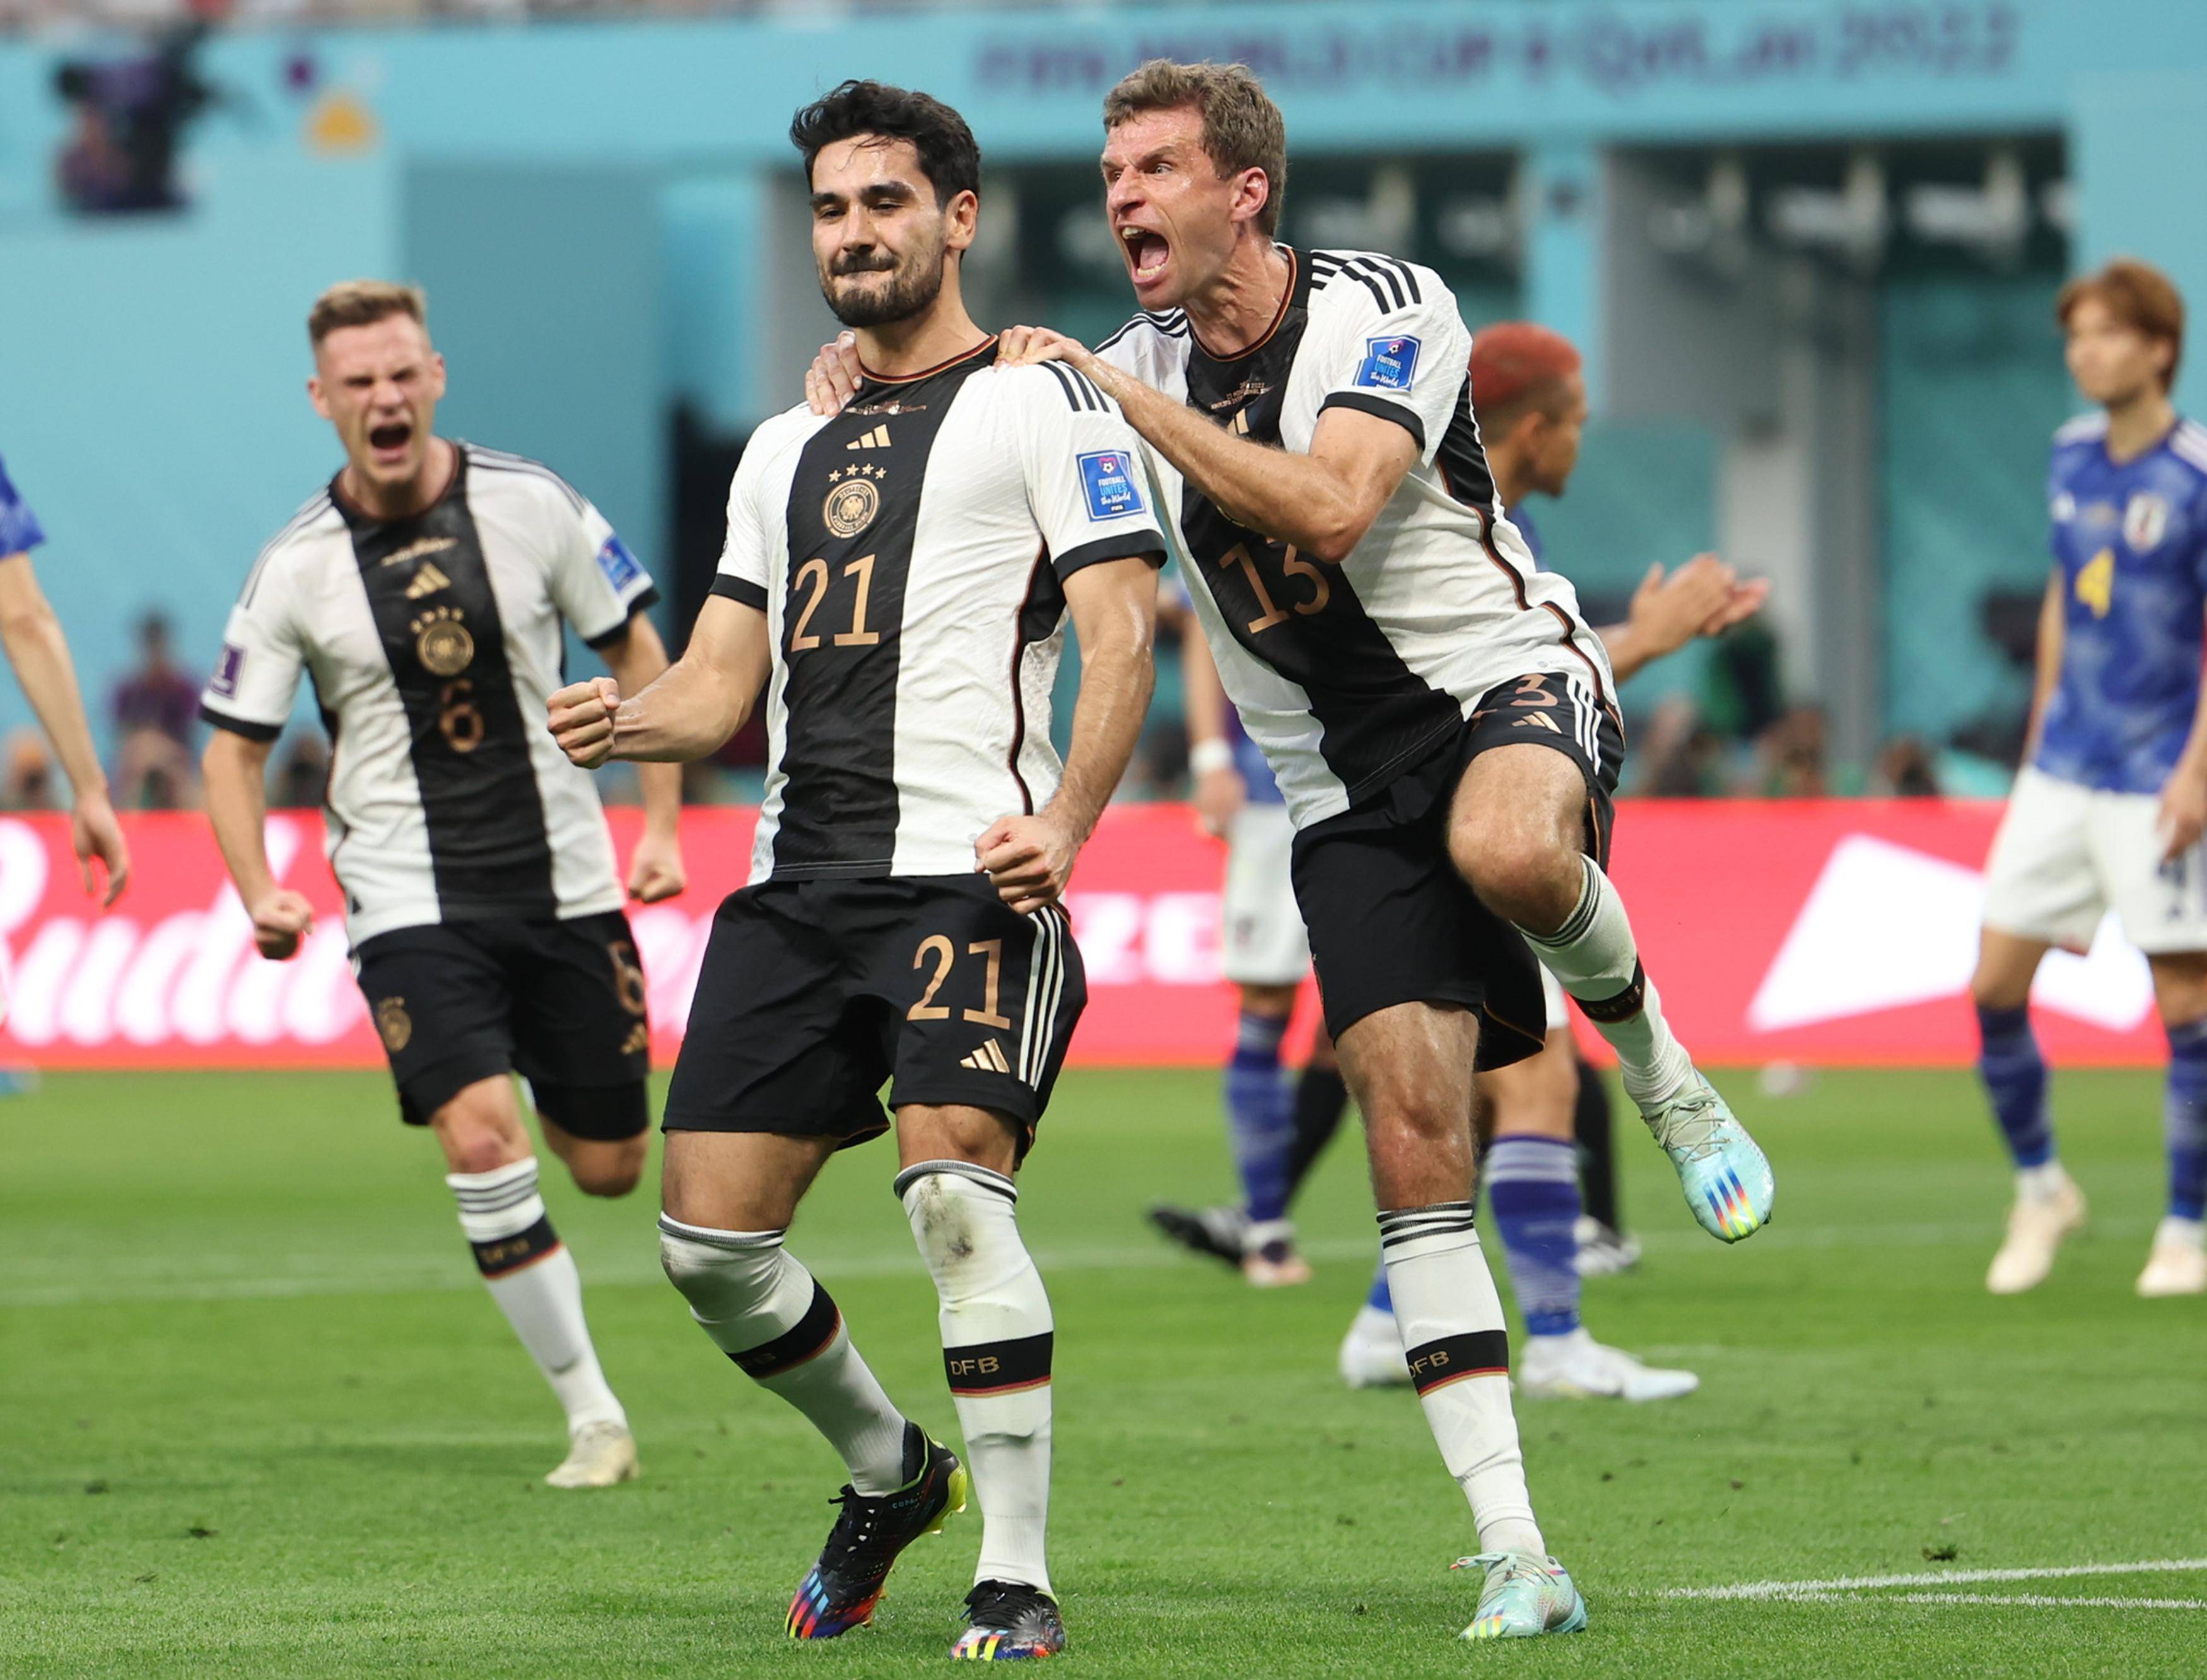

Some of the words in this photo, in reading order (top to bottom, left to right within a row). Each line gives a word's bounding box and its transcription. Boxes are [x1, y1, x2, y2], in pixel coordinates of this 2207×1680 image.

[1375, 363, 1400, 378] UNITES
[1100, 483, 1127, 496] UNITES
[791, 554, 880, 653] 21
[1218, 537, 1330, 634] 13
[440, 680, 484, 752] 6
[608, 941, 646, 1015] 6
[906, 934, 1010, 1030] 21
[950, 1356, 999, 1375] DFB
